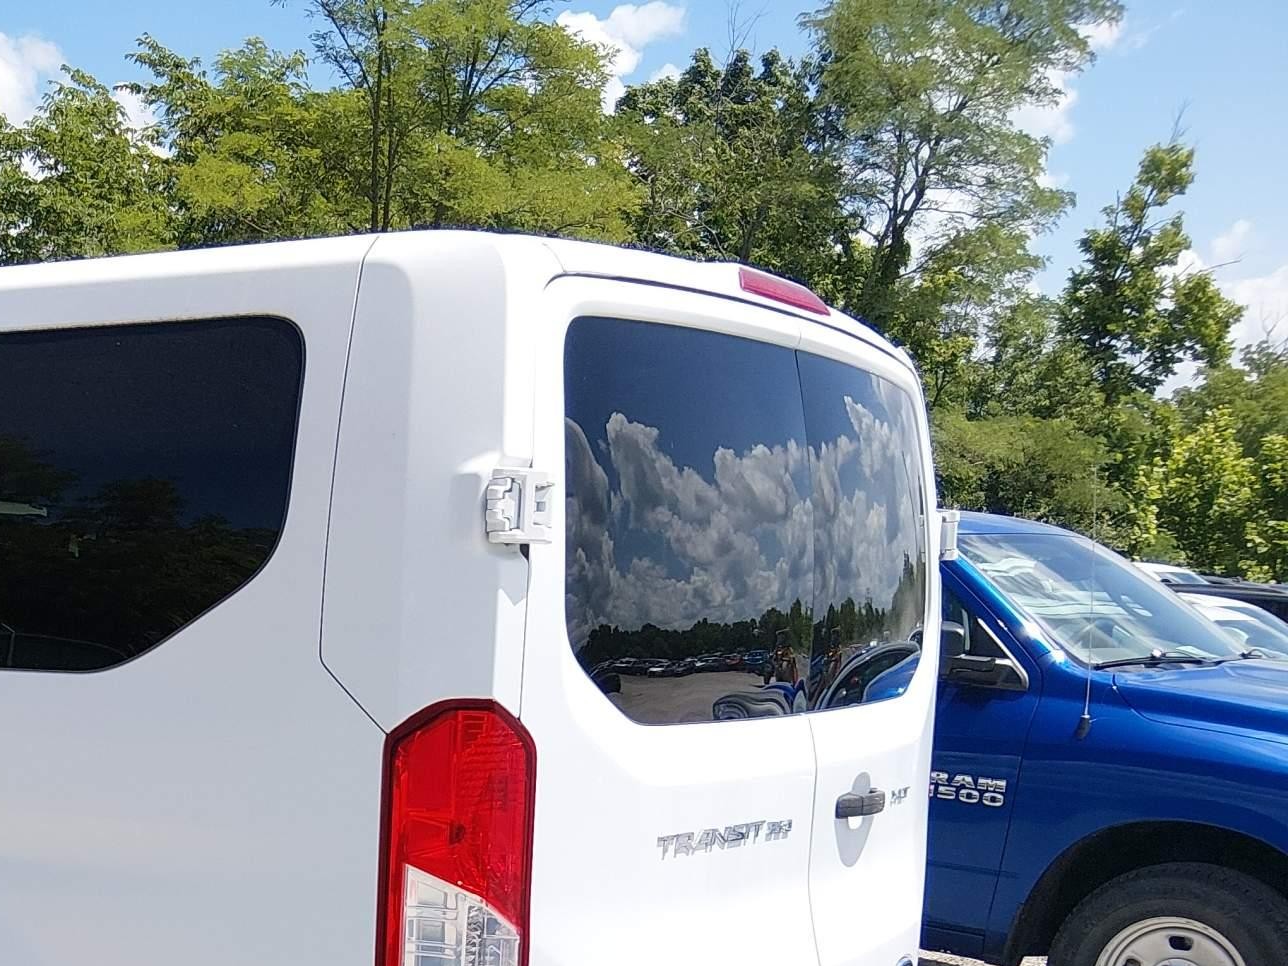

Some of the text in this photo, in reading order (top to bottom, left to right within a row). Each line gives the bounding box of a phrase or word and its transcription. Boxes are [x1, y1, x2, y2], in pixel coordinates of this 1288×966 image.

[930, 770, 1007, 793] RAM
[928, 783, 1004, 808] 1500
[657, 819, 767, 858] TRANSIT
